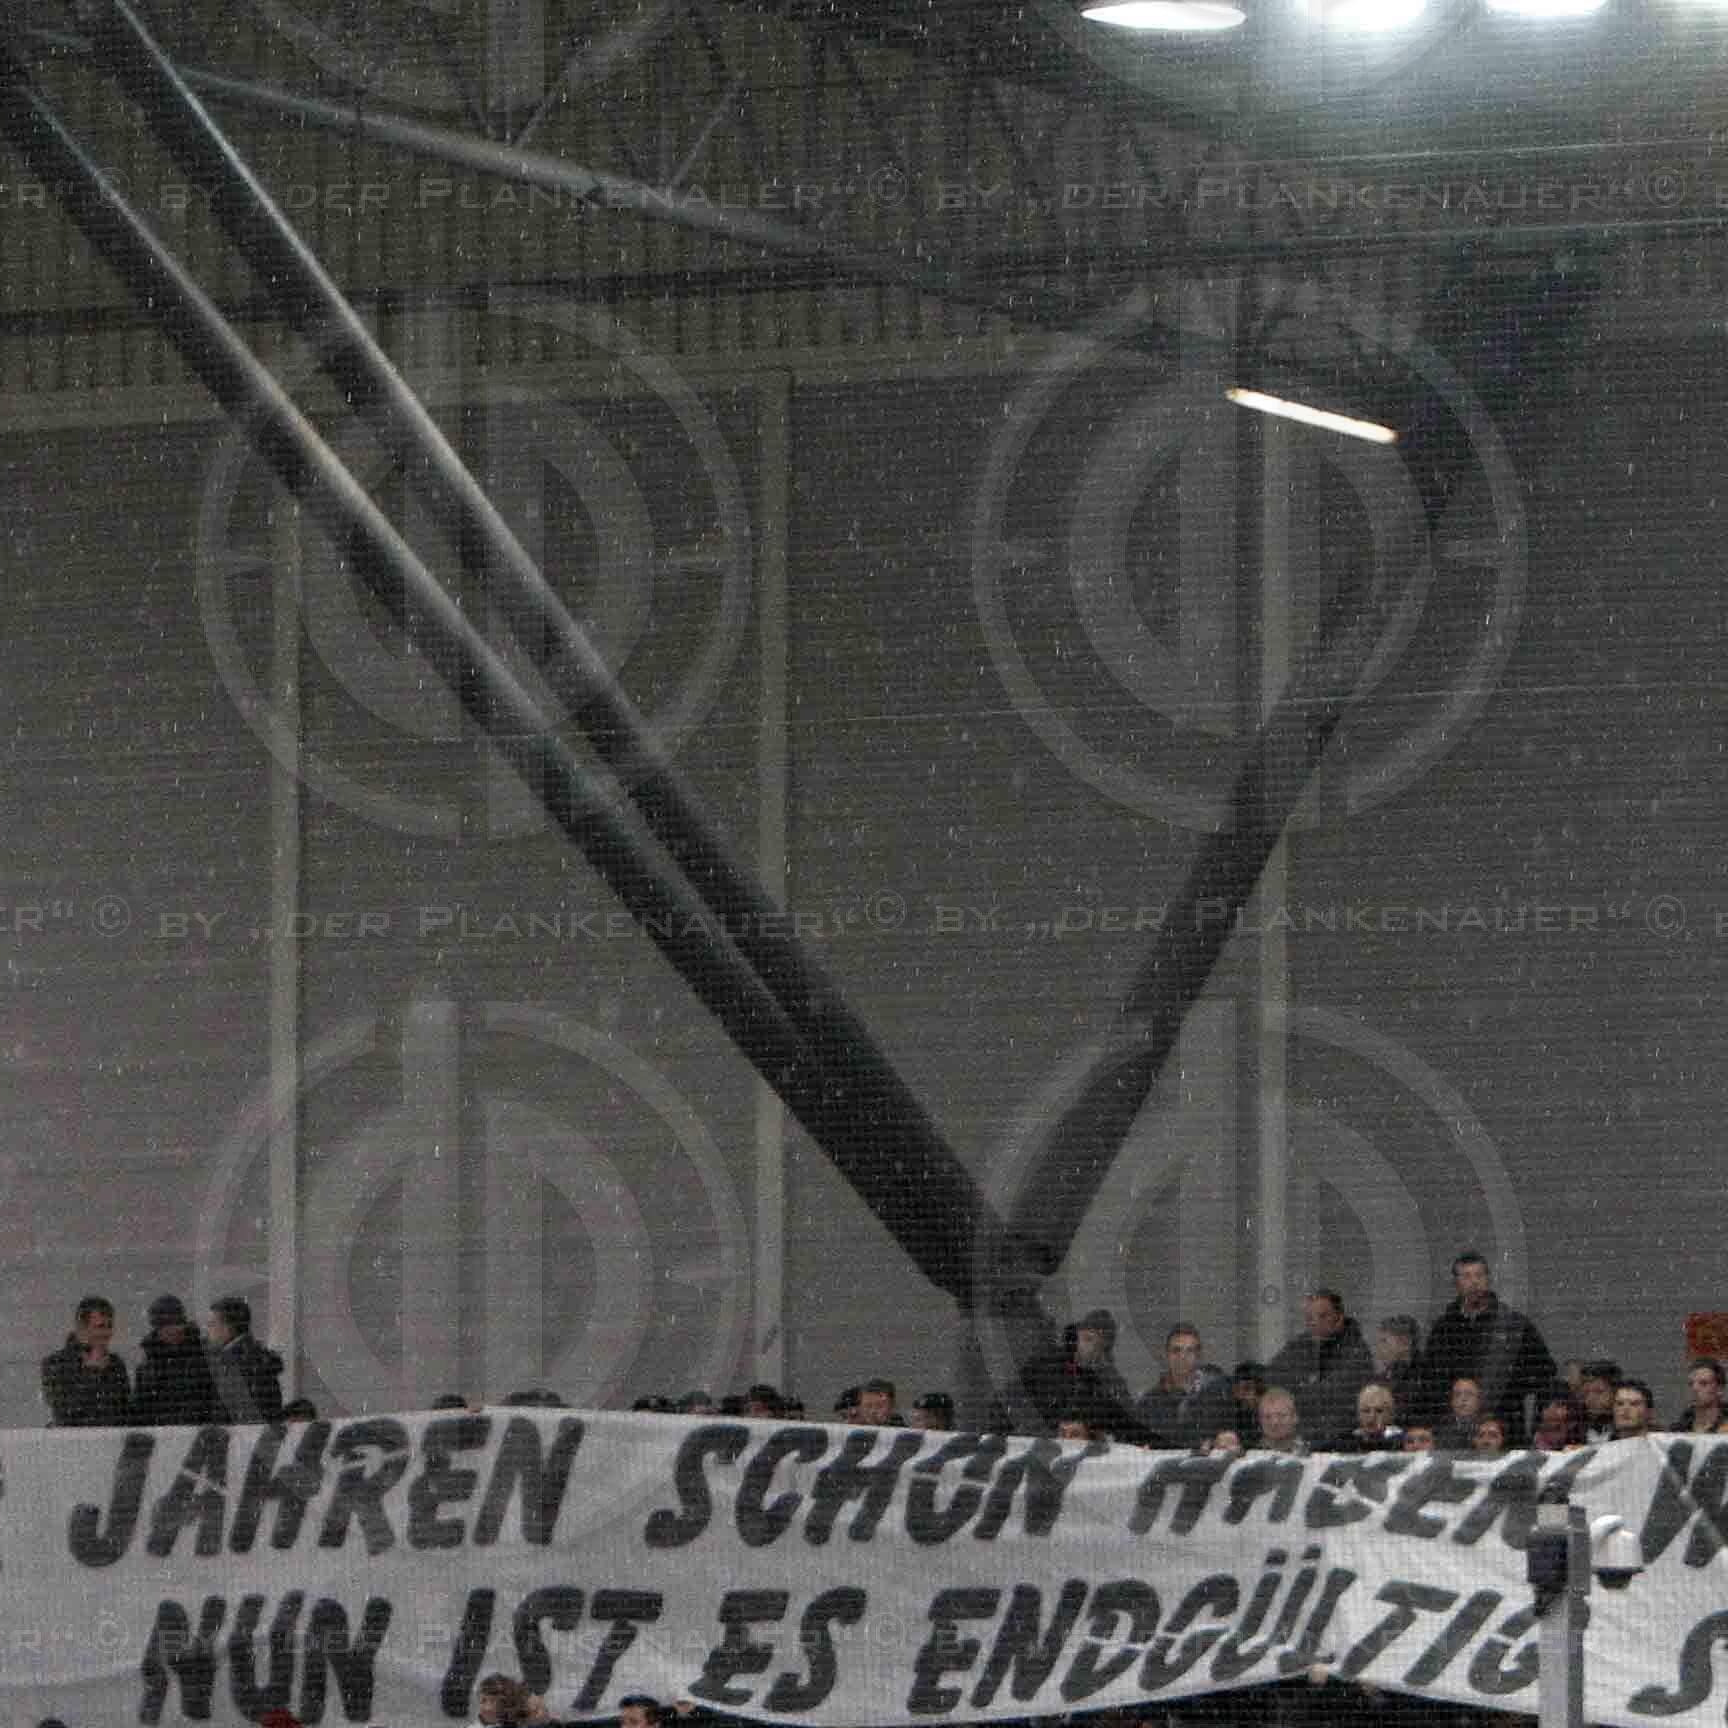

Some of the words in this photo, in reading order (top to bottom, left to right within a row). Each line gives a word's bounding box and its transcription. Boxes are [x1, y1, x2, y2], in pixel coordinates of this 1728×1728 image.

[67, 1415, 586, 1567] JAHREN
[644, 1424, 1110, 1548] SCHON
[138, 1589, 391, 1726] NUN
[440, 1586, 663, 1717] IST
[689, 1585, 867, 1713] ES
[906, 1545, 1542, 1715] ENDGÜLTIG
